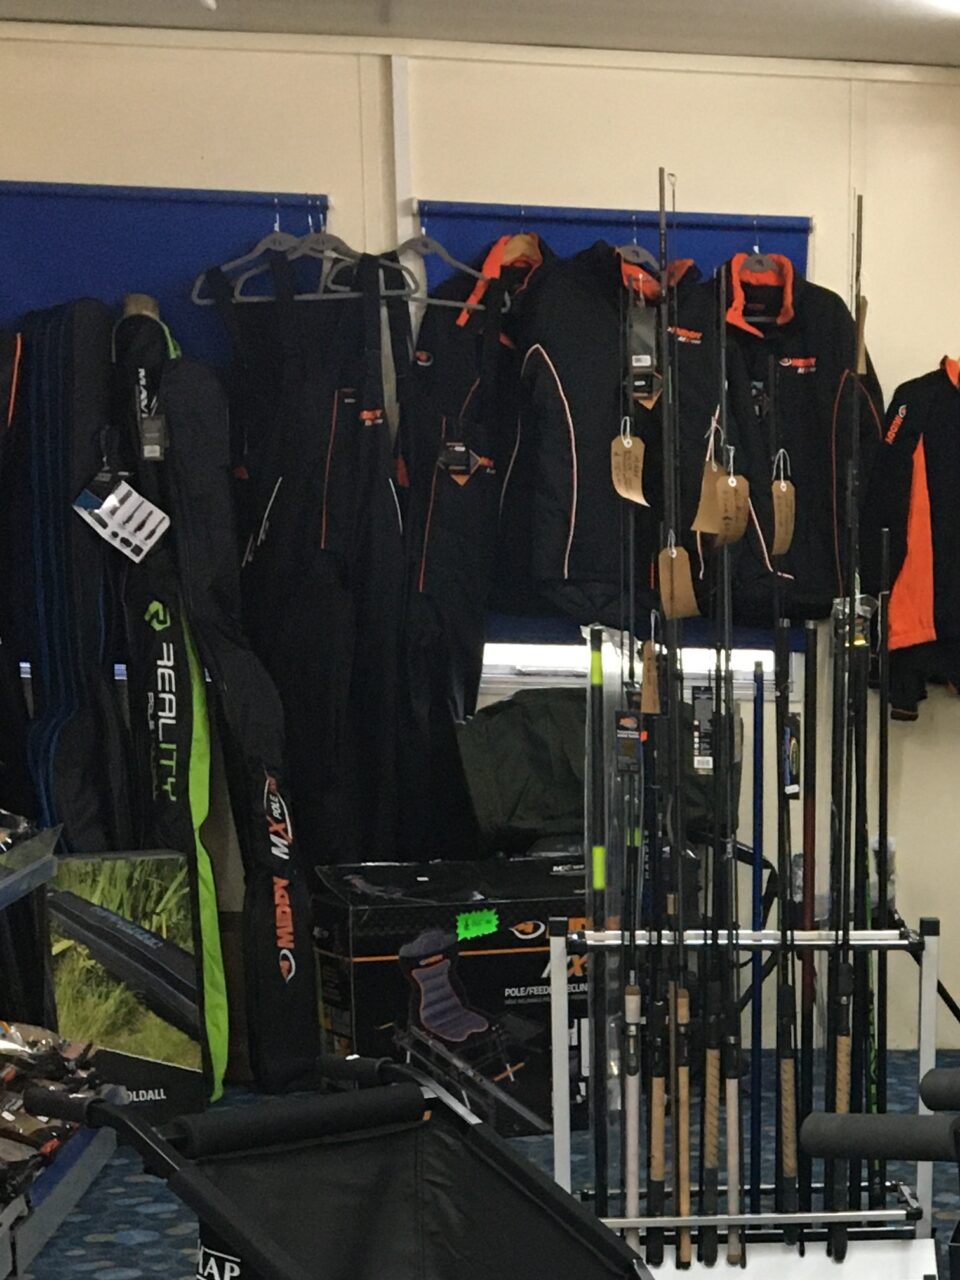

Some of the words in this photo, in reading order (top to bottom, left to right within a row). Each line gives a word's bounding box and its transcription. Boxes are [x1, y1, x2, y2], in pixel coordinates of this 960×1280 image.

[157, 642, 177, 802] REALITY
[272, 876, 295, 949] MIDDY
[505, 984, 551, 997] POLE/FEED
